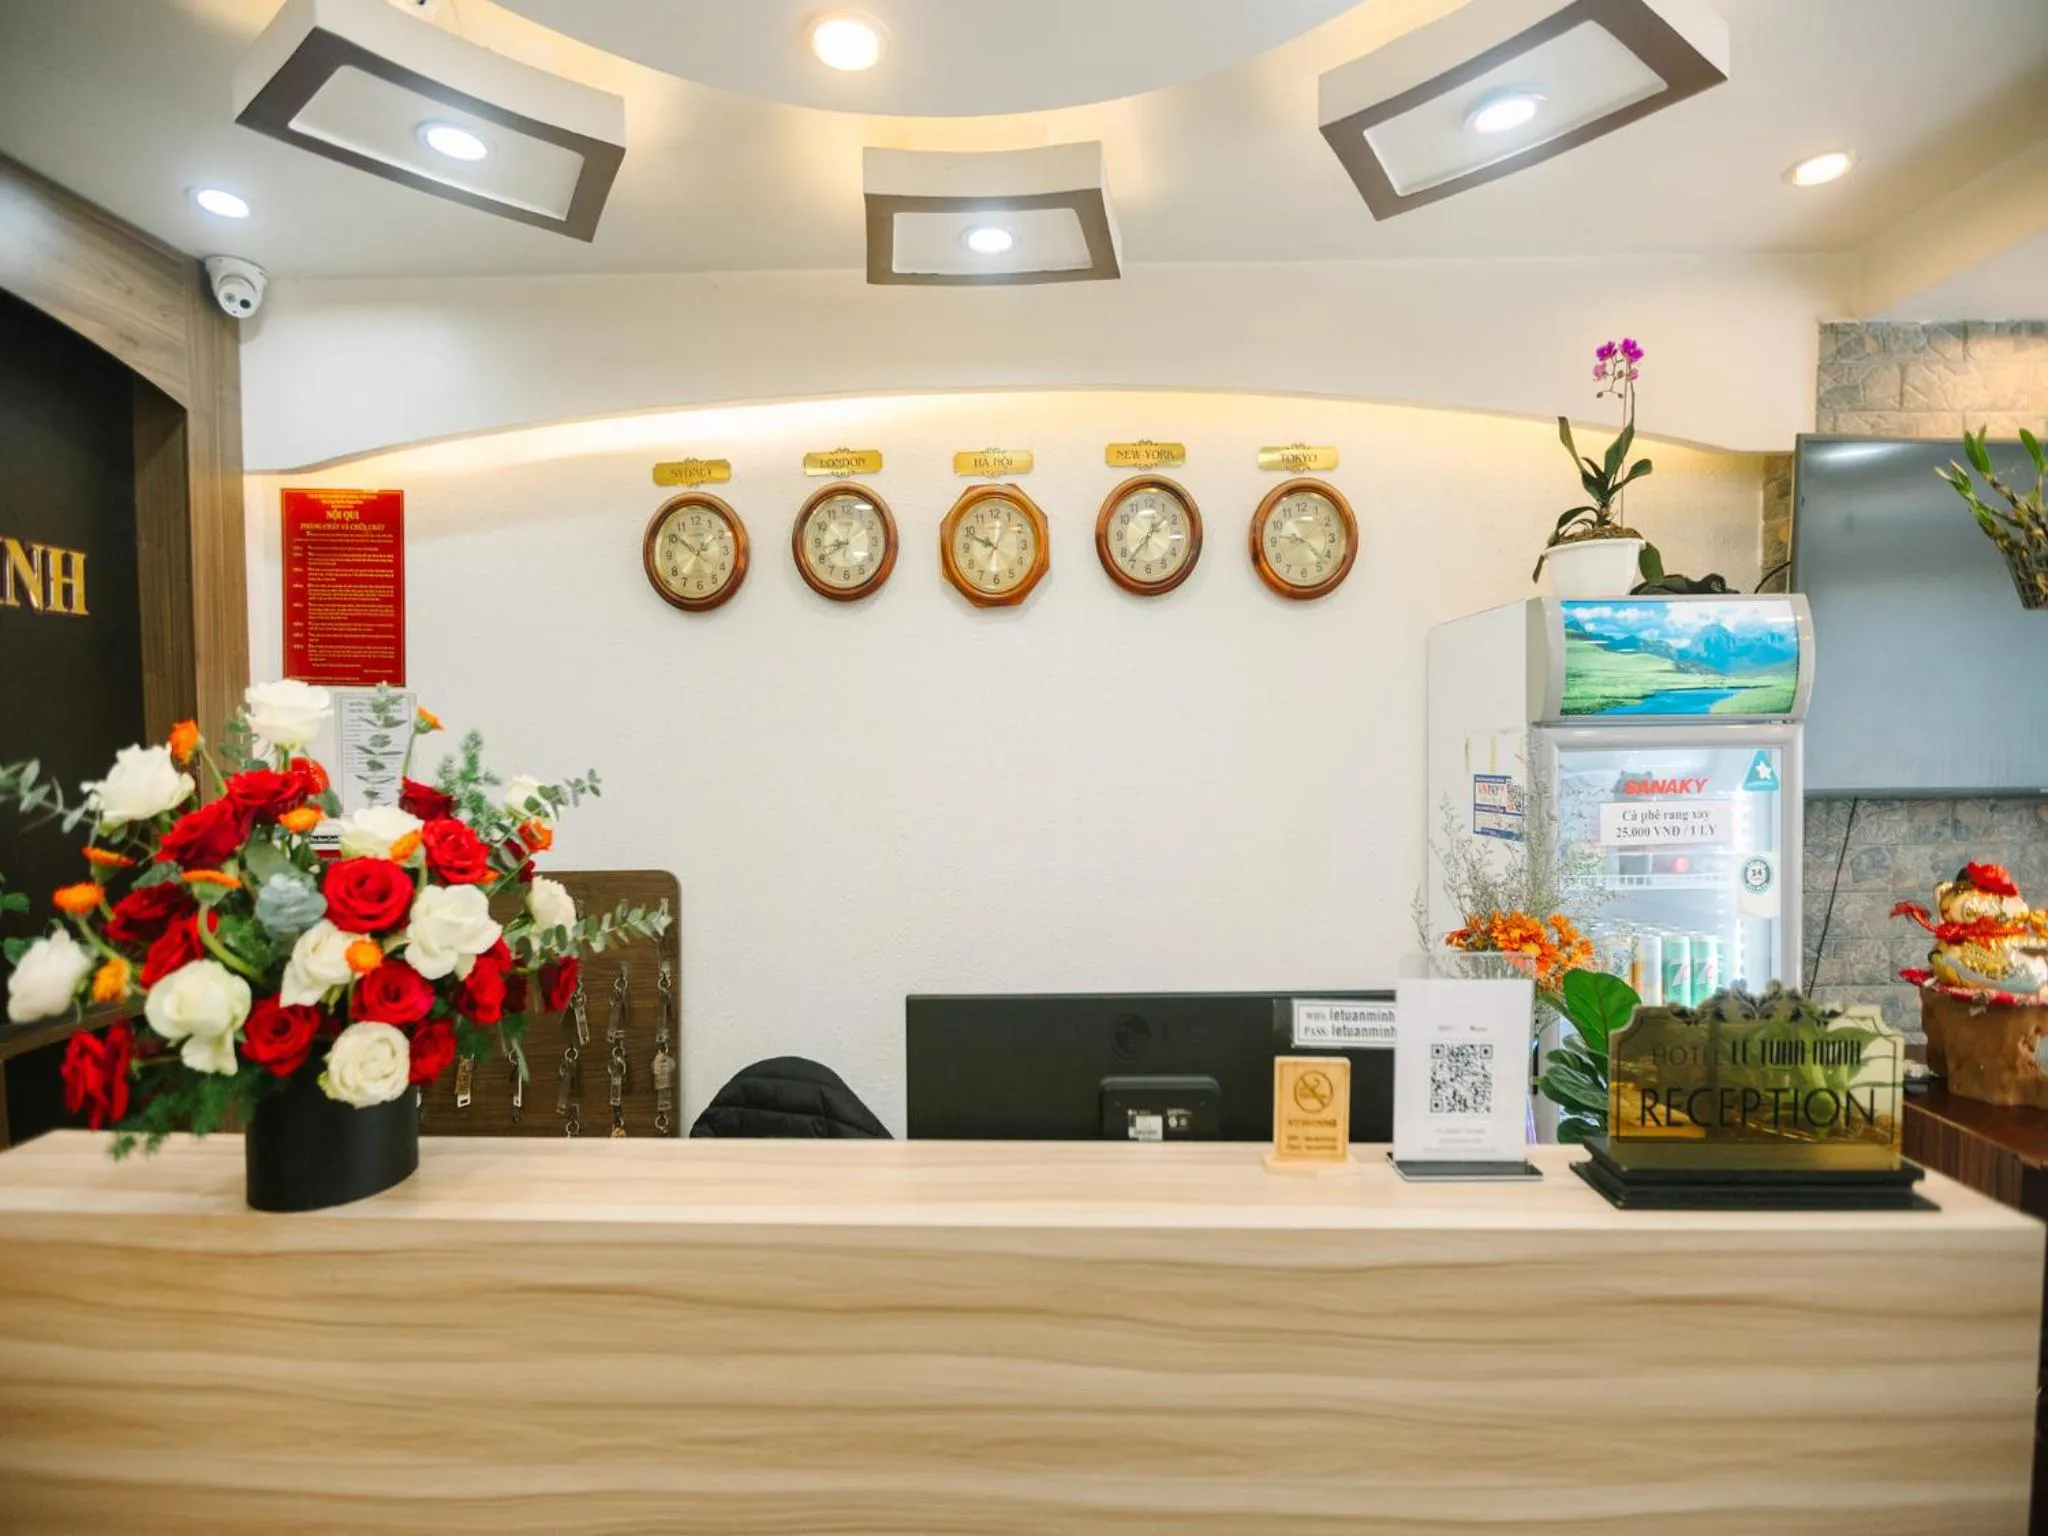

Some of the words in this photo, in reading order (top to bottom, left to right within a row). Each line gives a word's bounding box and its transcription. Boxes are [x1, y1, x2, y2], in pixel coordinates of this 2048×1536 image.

[1116, 450, 1135, 459] NEW
[1146, 449, 1175, 459] YORK
[1281, 454, 1317, 463] TOKYO
[820, 457, 866, 468] LONDON
[0, 537, 89, 615] NH
[1624, 776, 1712, 795] SANAKY
[1664, 810, 1688, 821] rang
[1330, 1008, 1395, 1023] letuanminh
[1640, 1087, 1877, 1128] RECEPTION
